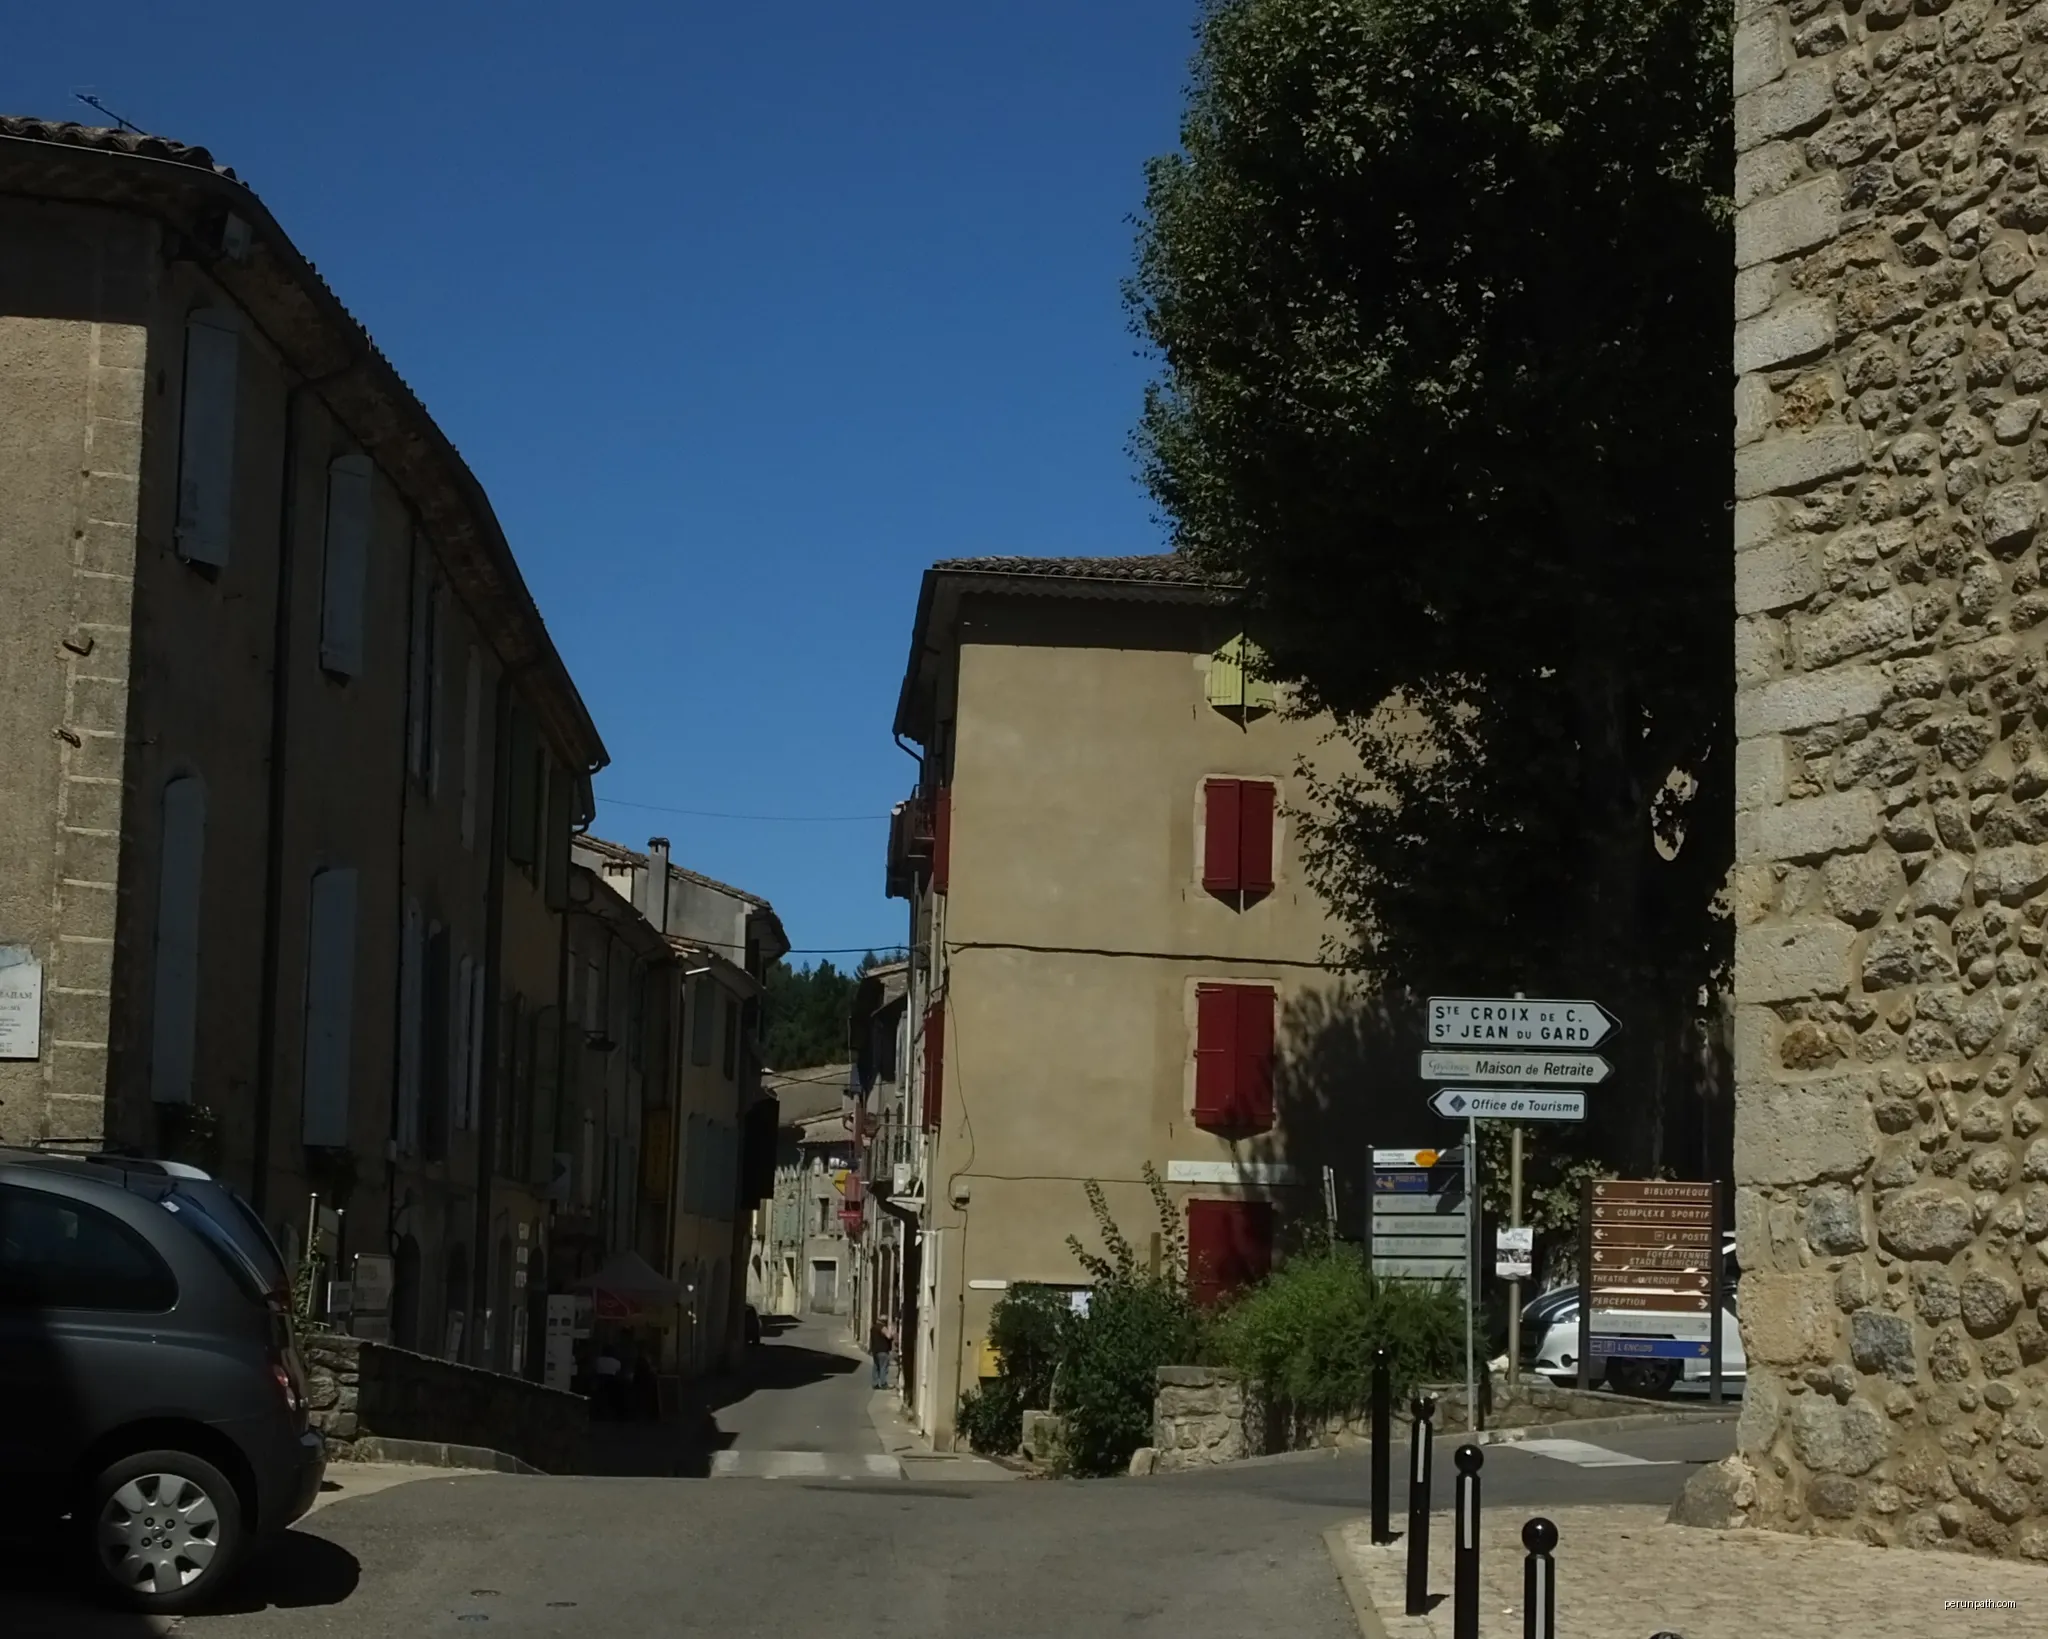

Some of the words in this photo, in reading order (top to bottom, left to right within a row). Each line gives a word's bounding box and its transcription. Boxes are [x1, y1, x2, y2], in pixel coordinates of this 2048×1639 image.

[1471, 1007, 1529, 1021] CROIX
[1540, 1013, 1555, 1022] DE
[1566, 1009, 1582, 1023] C.
[1461, 1025, 1508, 1039] JEAN
[1517, 1030, 1532, 1039] DU
[1540, 1027, 1589, 1041] GARD
[1475, 1061, 1522, 1075] Maison
[1525, 1064, 1539, 1075] de
[1543, 1062, 1594, 1077] Retraite
[1471, 1098, 1507, 1111] Office
[1510, 1099, 1525, 1111] de
[1528, 1100, 1580, 1113] Tourisme
[1616, 1208, 1665, 1218] COMPLEXE
[1671, 1210, 1710, 1219] SPORTIF
[1666, 1233, 1678, 1241] LA
[1682, 1233, 1709, 1242] POSTE
[1592, 1296, 1646, 1306] PERCEPTION
